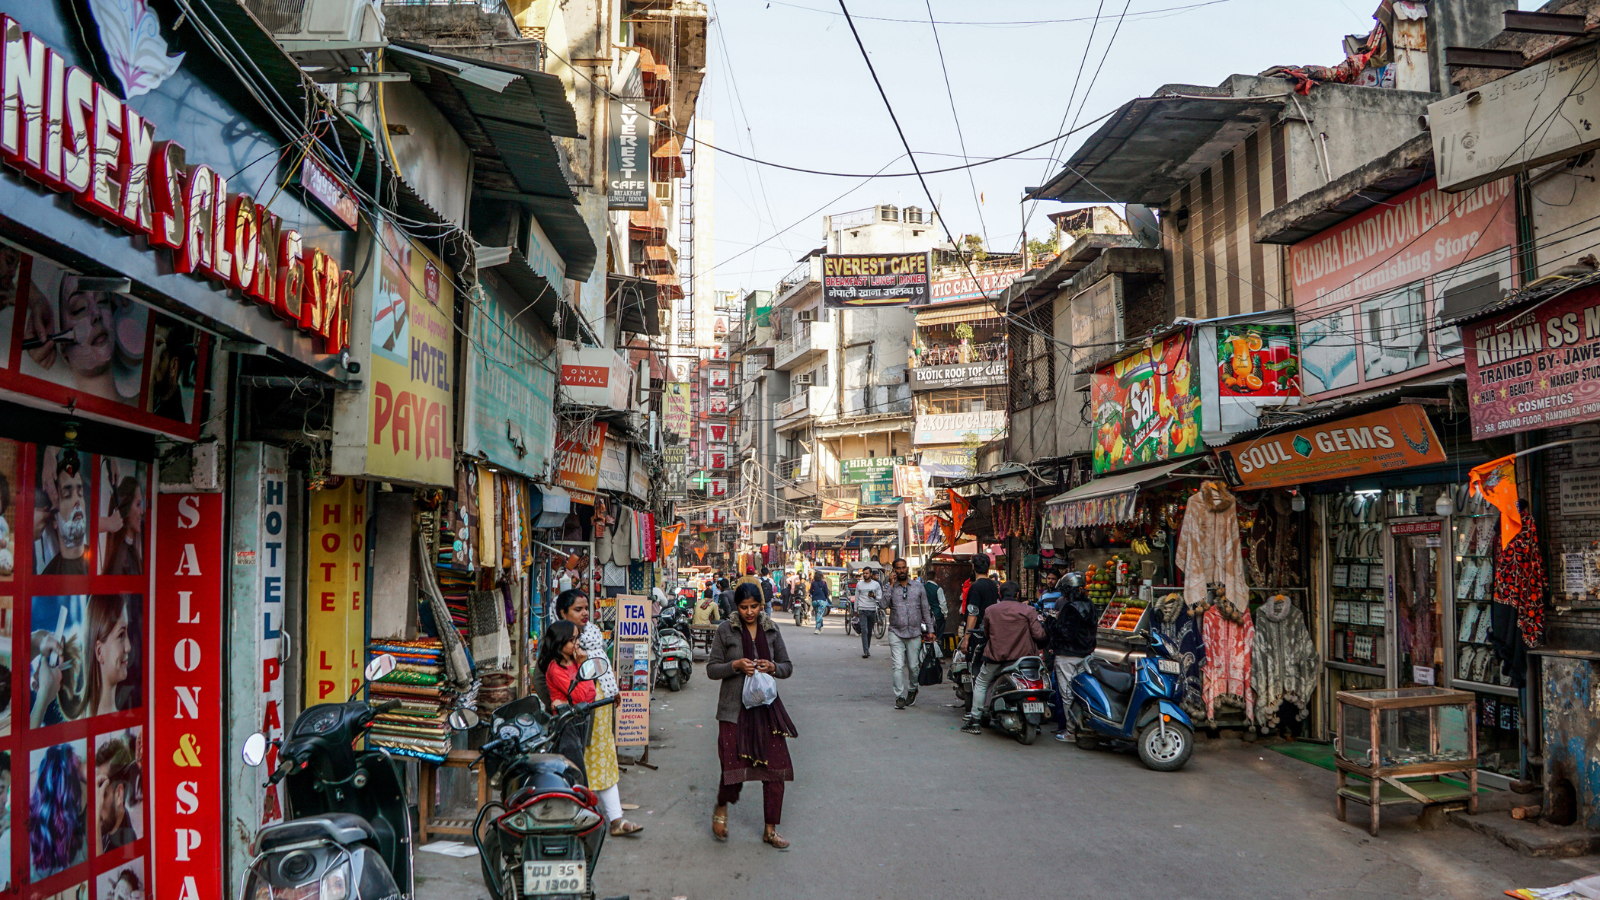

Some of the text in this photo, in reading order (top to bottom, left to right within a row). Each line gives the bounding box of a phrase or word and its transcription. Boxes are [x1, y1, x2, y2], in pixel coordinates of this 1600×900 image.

[619, 103, 639, 179] EVEREST
[611, 180, 645, 190] CAFE
[150, 139, 283, 305] SALON
[300, 246, 354, 355] SPA
[1292, 234, 1342, 288] CHADHA
[1340, 199, 1420, 264] HANDLOOM
[824, 255, 926, 276] EVEREST CAFE
[1316, 230, 1480, 309] Home Furnishing Store
[825, 274, 926, 287] BREAKFAST LUNCH DINNER
[1475, 324, 1492, 338] ONLY
[1475, 322, 1543, 368] KIRAN
[1546, 313, 1580, 348] SS
[411, 335, 450, 392] HOTEL
[570, 368, 599, 376] ONLY
[916, 369, 943, 381] EXOTIC
[944, 367, 966, 378] ROOF
[967, 366, 984, 377] TOP
[985, 364, 1004, 376] CAFE
[1479, 359, 1533, 386] TRAINED
[564, 375, 605, 384] VIMAL
[1480, 388, 1496, 404] HAIR
[1509, 380, 1534, 397] BEAUTY
[1550, 370, 1579, 388] MAKEUP
[1130, 376, 1154, 430] Sai
[1517, 392, 1574, 413] COSMETICS
[374, 380, 452, 462] PAYAL
[920, 414, 964, 431] EXOTIC
[965, 412, 997, 429] CAFE
[1497, 418, 1521, 430] GROUND
[1238, 440, 1293, 474] SOUL
[1314, 425, 1395, 454] GEMS
[849, 456, 904, 469] HIRA SONS
[868, 483, 886, 492] HIRA
[1415, 522, 1440, 531] JEWELLERY
[264, 480, 283, 640] HOTEL
[320, 503, 341, 613] HOTEL
[352, 504, 364, 611] HOTEL
[624, 604, 645, 619] TEA
[619, 621, 649, 635] INDIA
[172, 495, 203, 900] SALON & SPA
[545, 879, 579, 890] 1300
